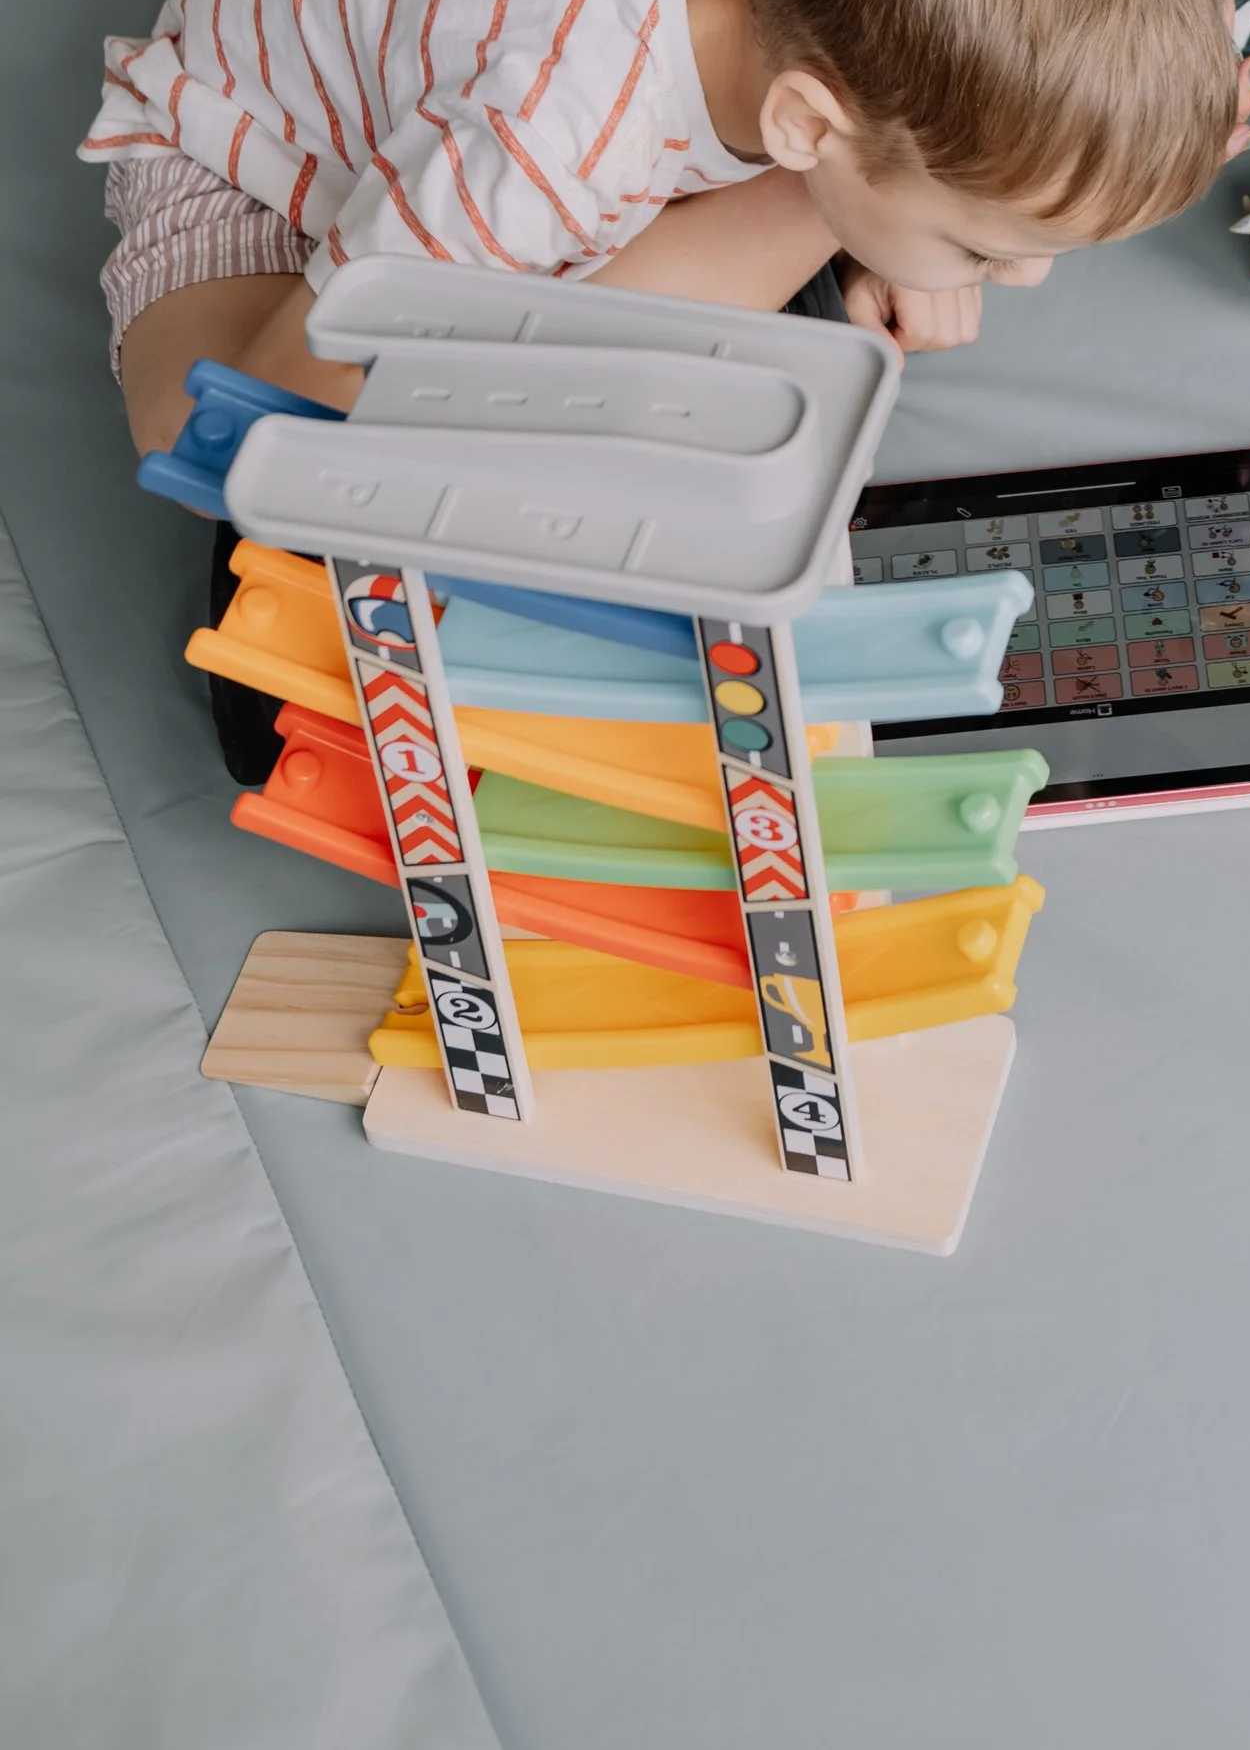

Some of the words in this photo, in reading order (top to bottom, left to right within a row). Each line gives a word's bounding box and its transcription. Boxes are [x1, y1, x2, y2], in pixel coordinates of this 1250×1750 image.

[1069, 707, 1096, 715] Home
[397, 750, 426, 775] 1
[749, 815, 784, 842] 3
[450, 997, 484, 1023] 2
[792, 1100, 827, 1125] 4
